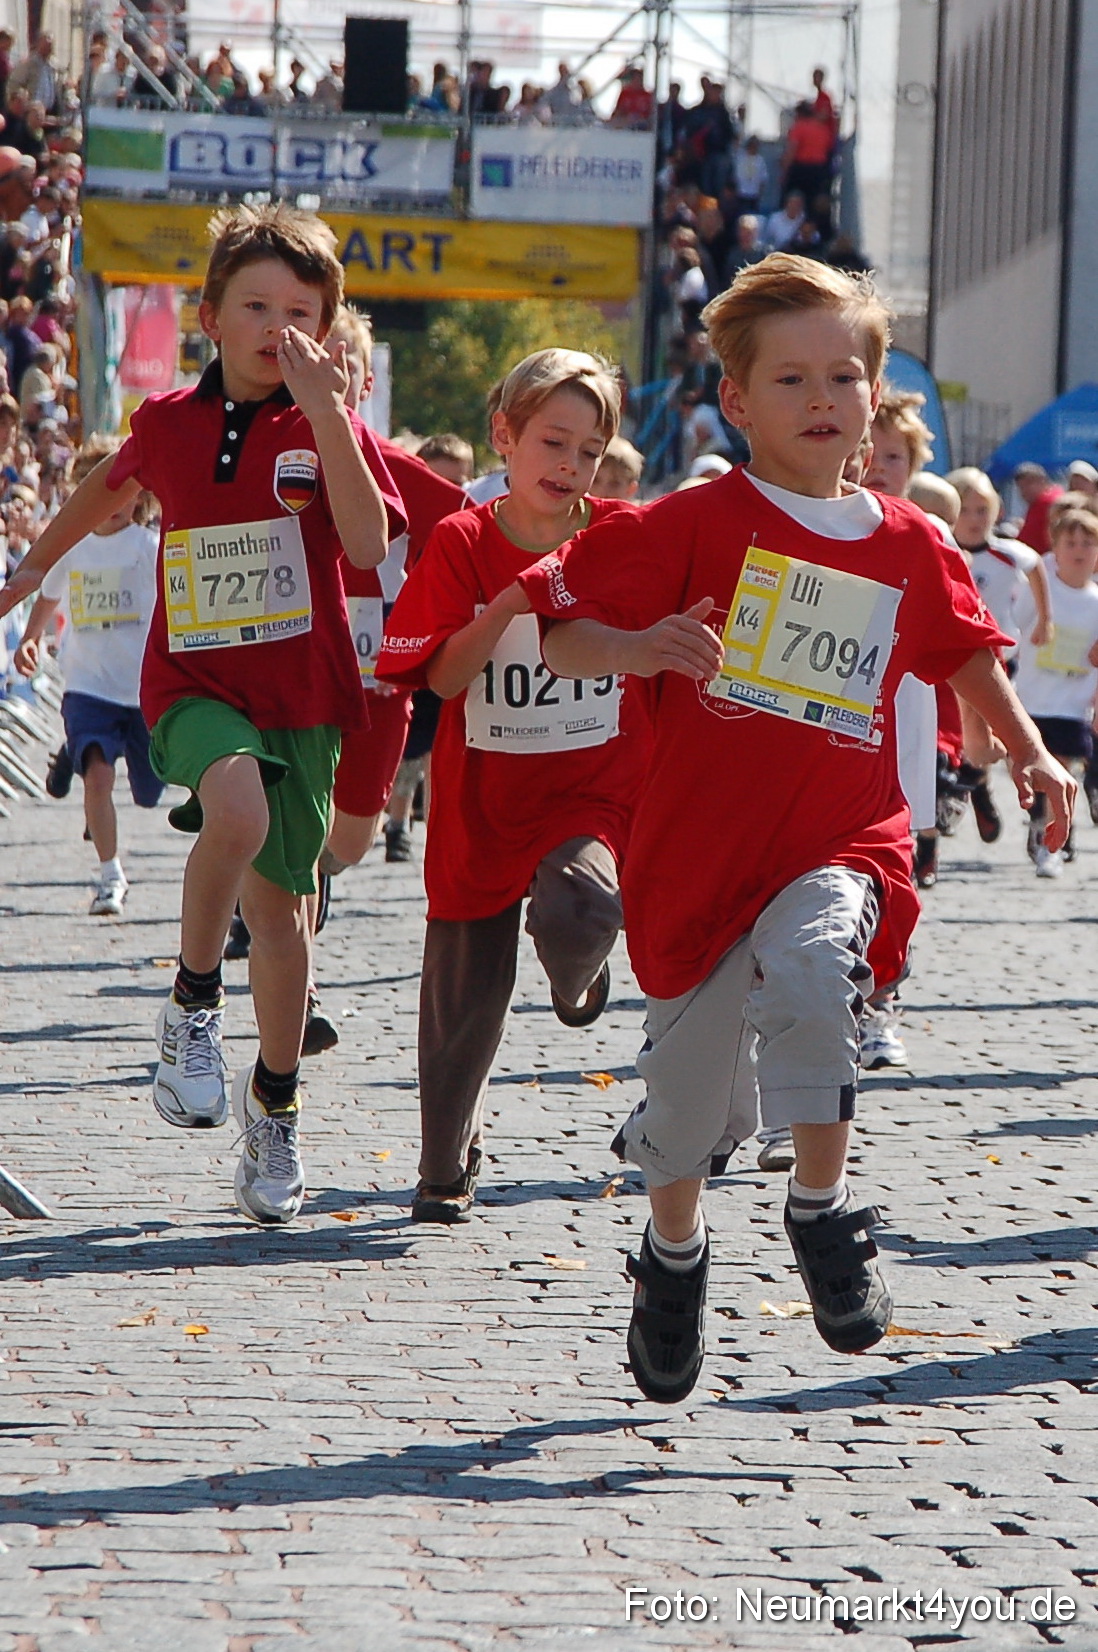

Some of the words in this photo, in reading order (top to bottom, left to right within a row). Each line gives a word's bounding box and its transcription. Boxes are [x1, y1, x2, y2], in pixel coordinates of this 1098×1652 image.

[169, 130, 378, 180] BOCK
[519, 155, 643, 179] PFLEIDERER
[196, 532, 281, 560] Jonathan
[169, 575, 186, 594] K4
[202, 565, 297, 607] 7278
[790, 572, 824, 607] Uli
[257, 615, 310, 633] PFLEIDERER
[735, 605, 760, 630] K4
[780, 621, 880, 686] 7094
